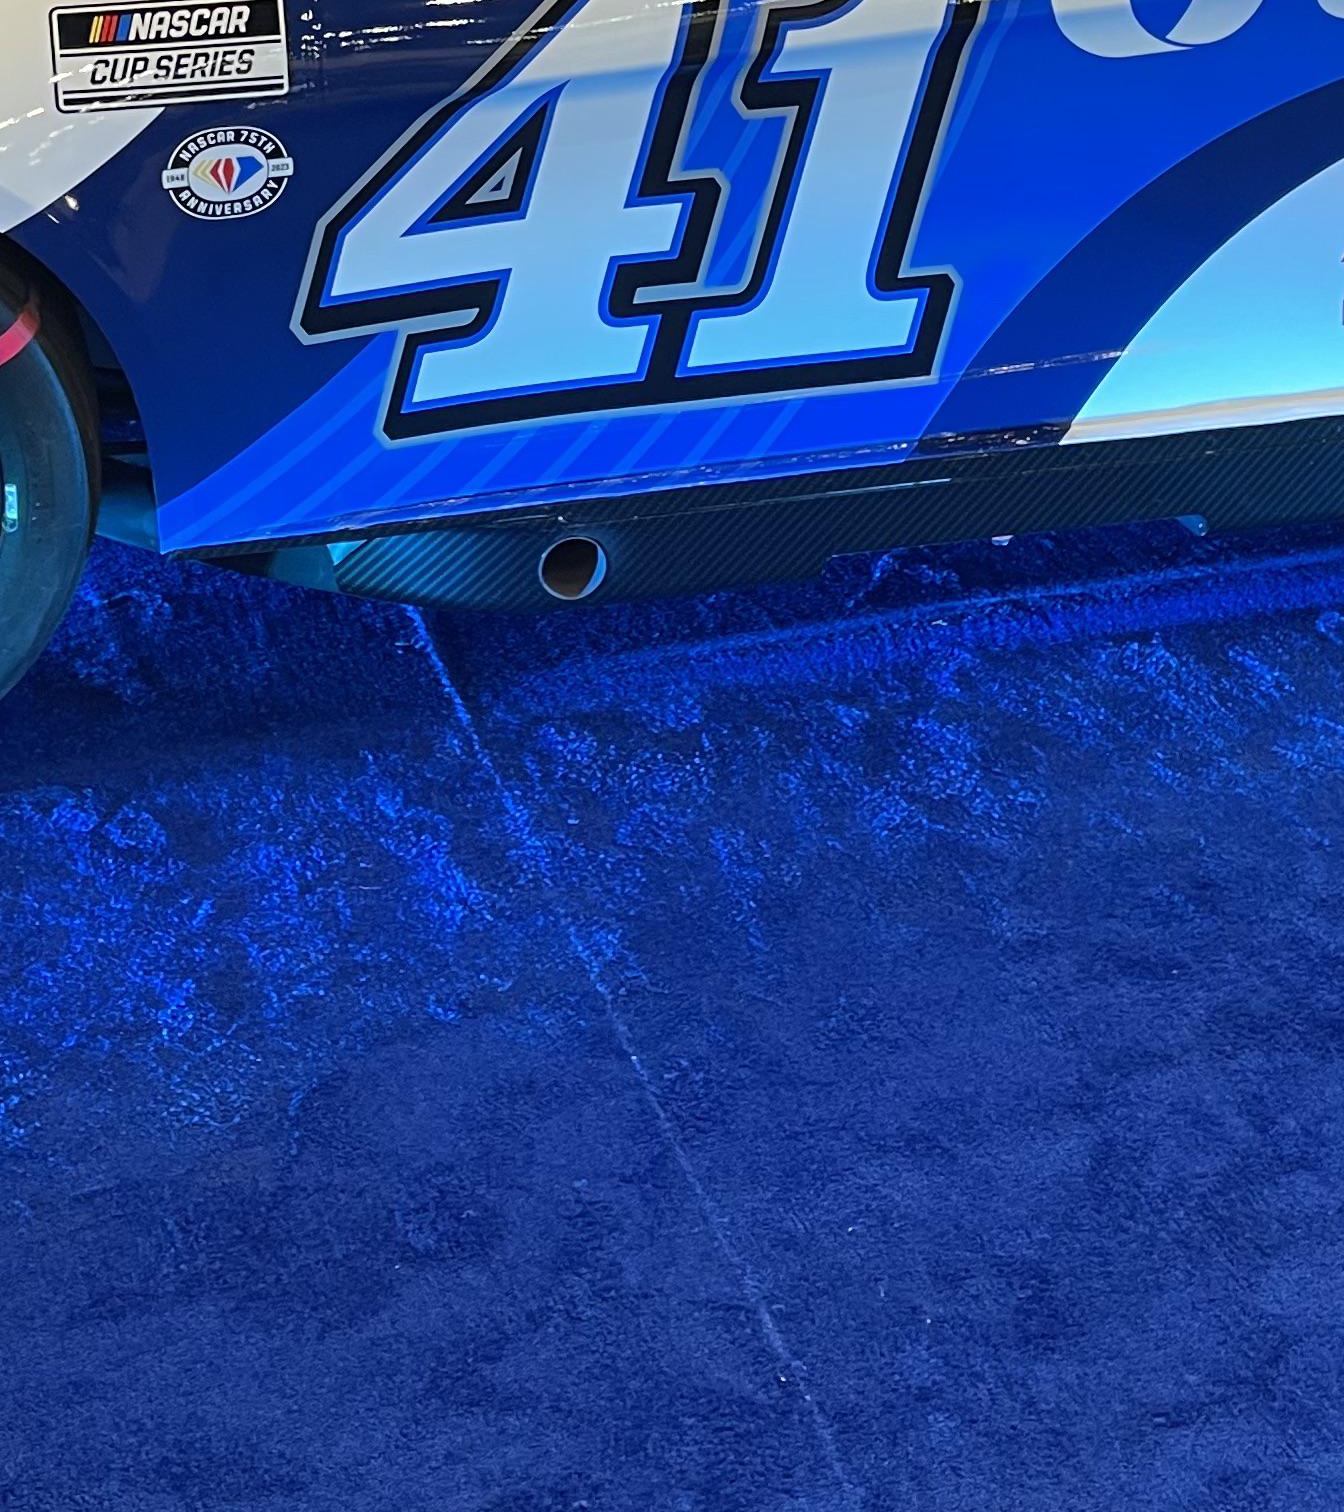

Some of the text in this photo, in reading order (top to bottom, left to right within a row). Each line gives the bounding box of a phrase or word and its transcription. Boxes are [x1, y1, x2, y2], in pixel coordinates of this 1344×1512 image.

[128, 5, 251, 42] NASCAR
[89, 49, 255, 86] CUP SERIES
[178, 130, 276, 163] NASCAR 75TH
[178, 180, 279, 216] ANNIVERSARY
